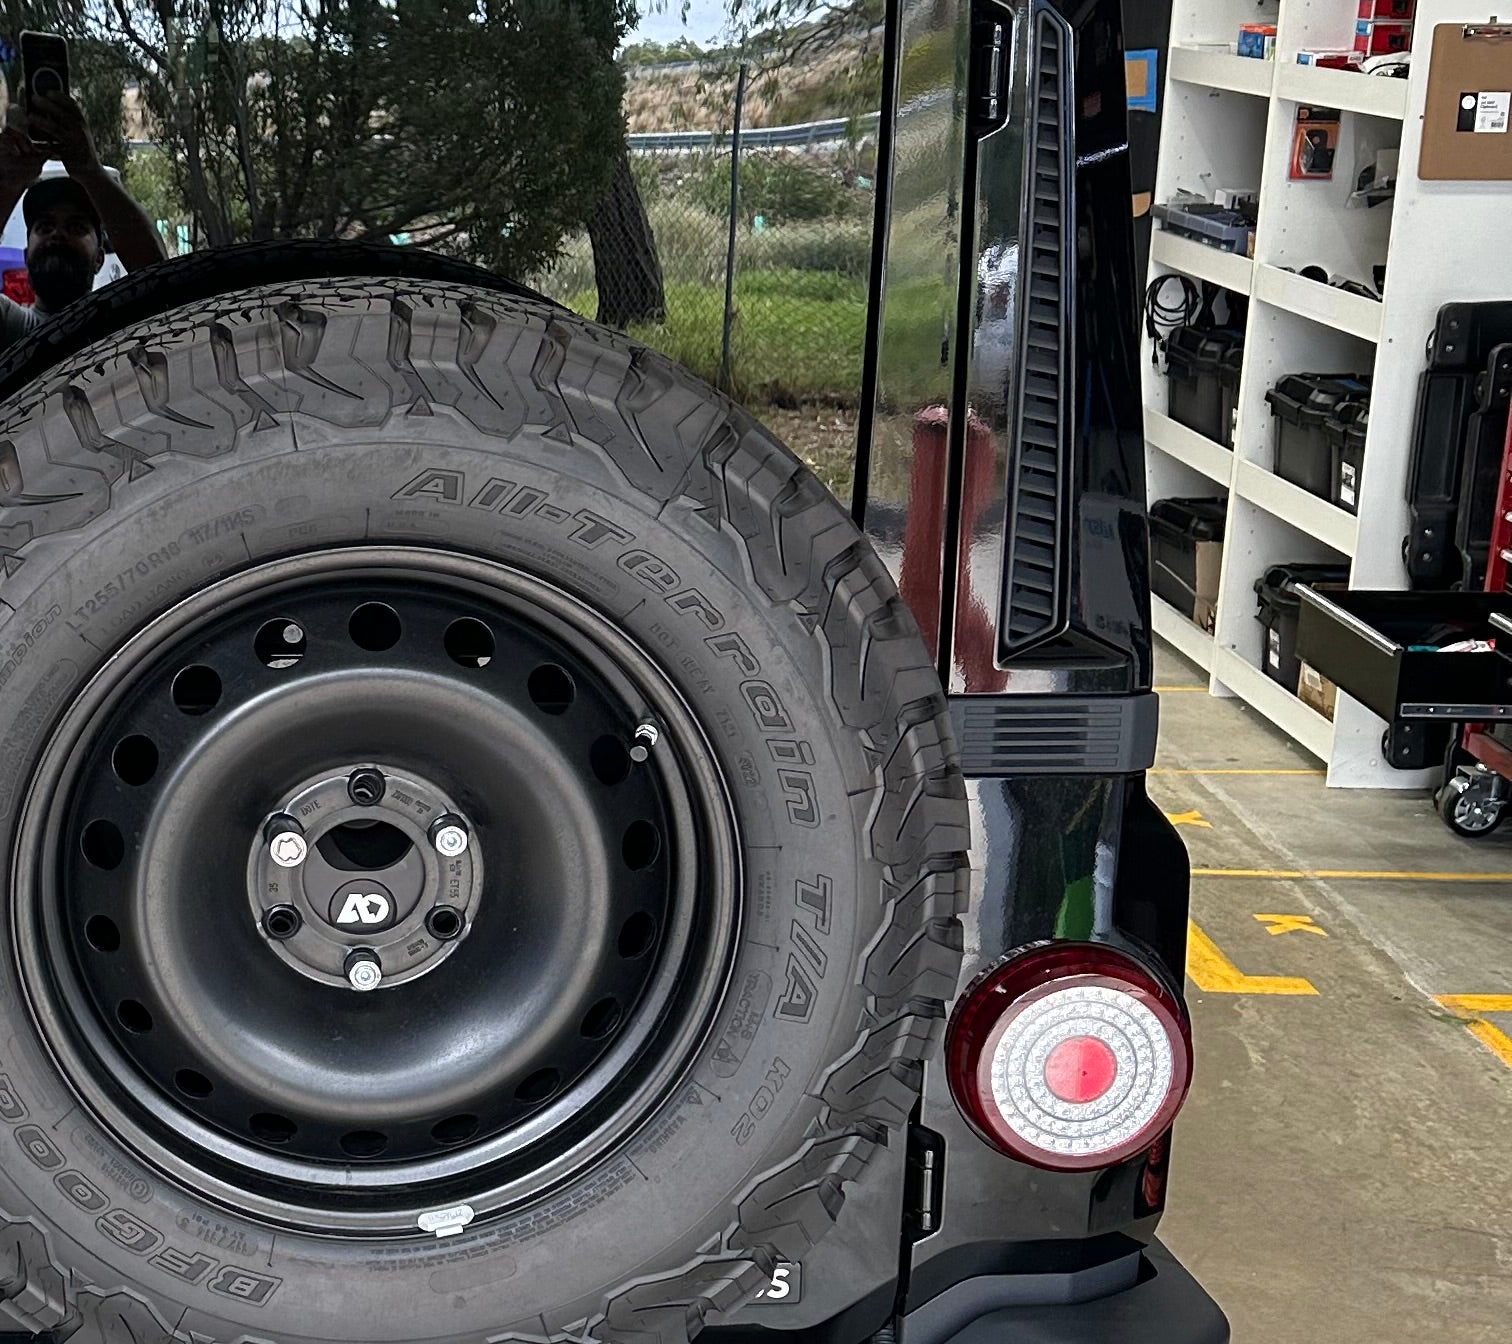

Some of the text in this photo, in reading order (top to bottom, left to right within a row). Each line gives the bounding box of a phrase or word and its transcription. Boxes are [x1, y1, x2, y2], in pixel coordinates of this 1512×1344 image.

[389, 467, 820, 829] All-Terrain
[773, 874, 833, 1024] T/A
[731, 1057, 791, 1146] KO2
